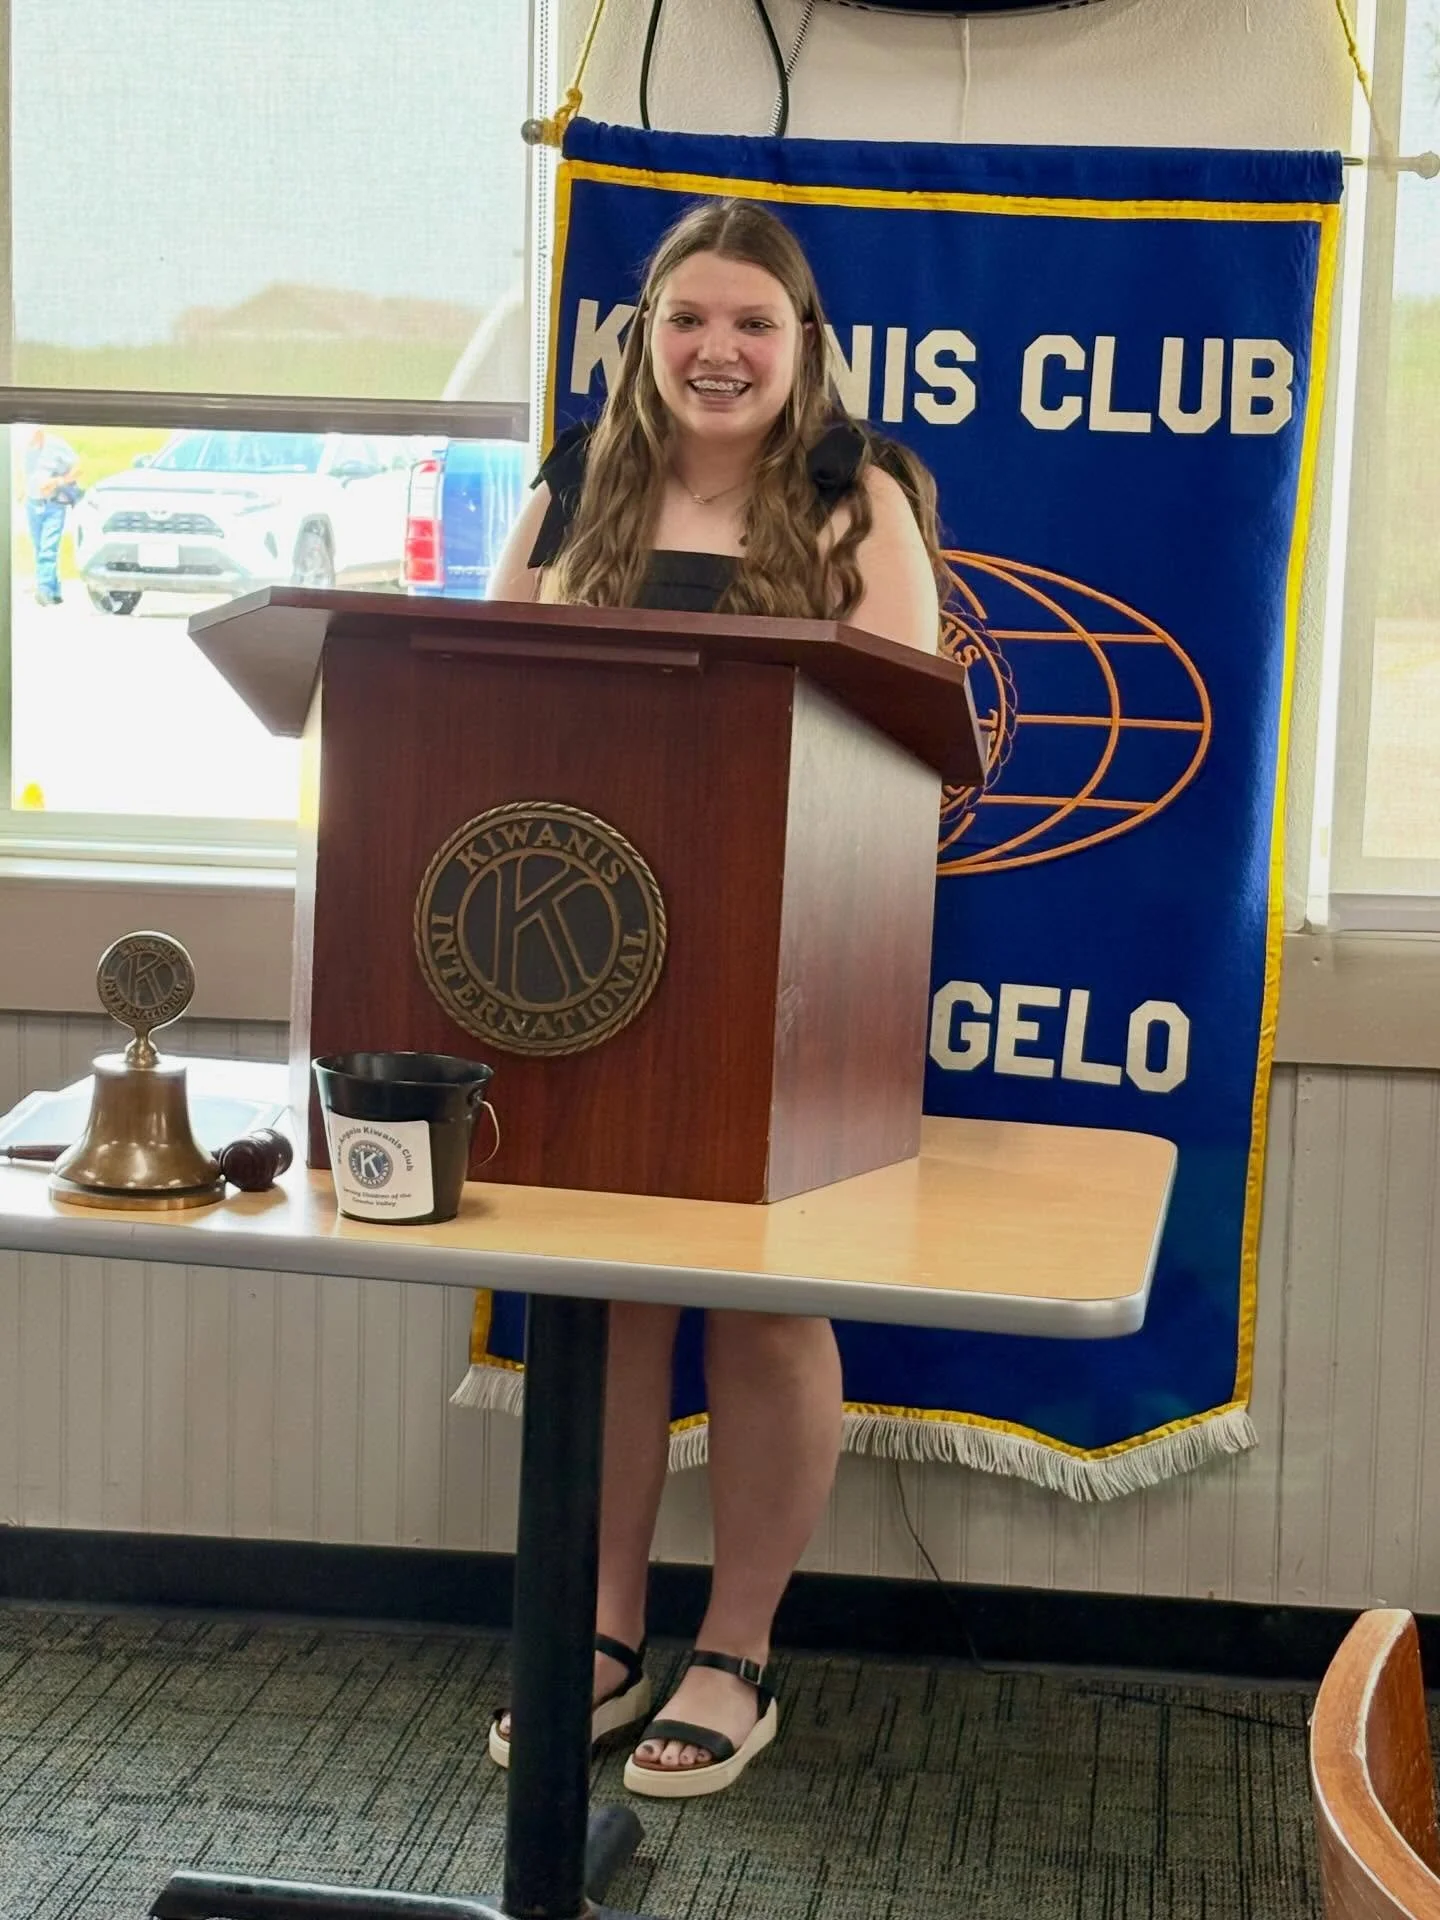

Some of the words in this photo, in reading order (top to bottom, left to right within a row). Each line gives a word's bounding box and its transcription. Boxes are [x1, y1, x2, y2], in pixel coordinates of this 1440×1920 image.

[570, 298, 976, 424] KNIS
[1020, 334, 1295, 435] CLUB
[455, 820, 627, 886] KIWANIS
[431, 912, 649, 1039] INTERNATIONAL
[928, 979, 1191, 1093] GELO
[363, 1126, 402, 1150] Kiwanis
[401, 1147, 415, 1172] Club
